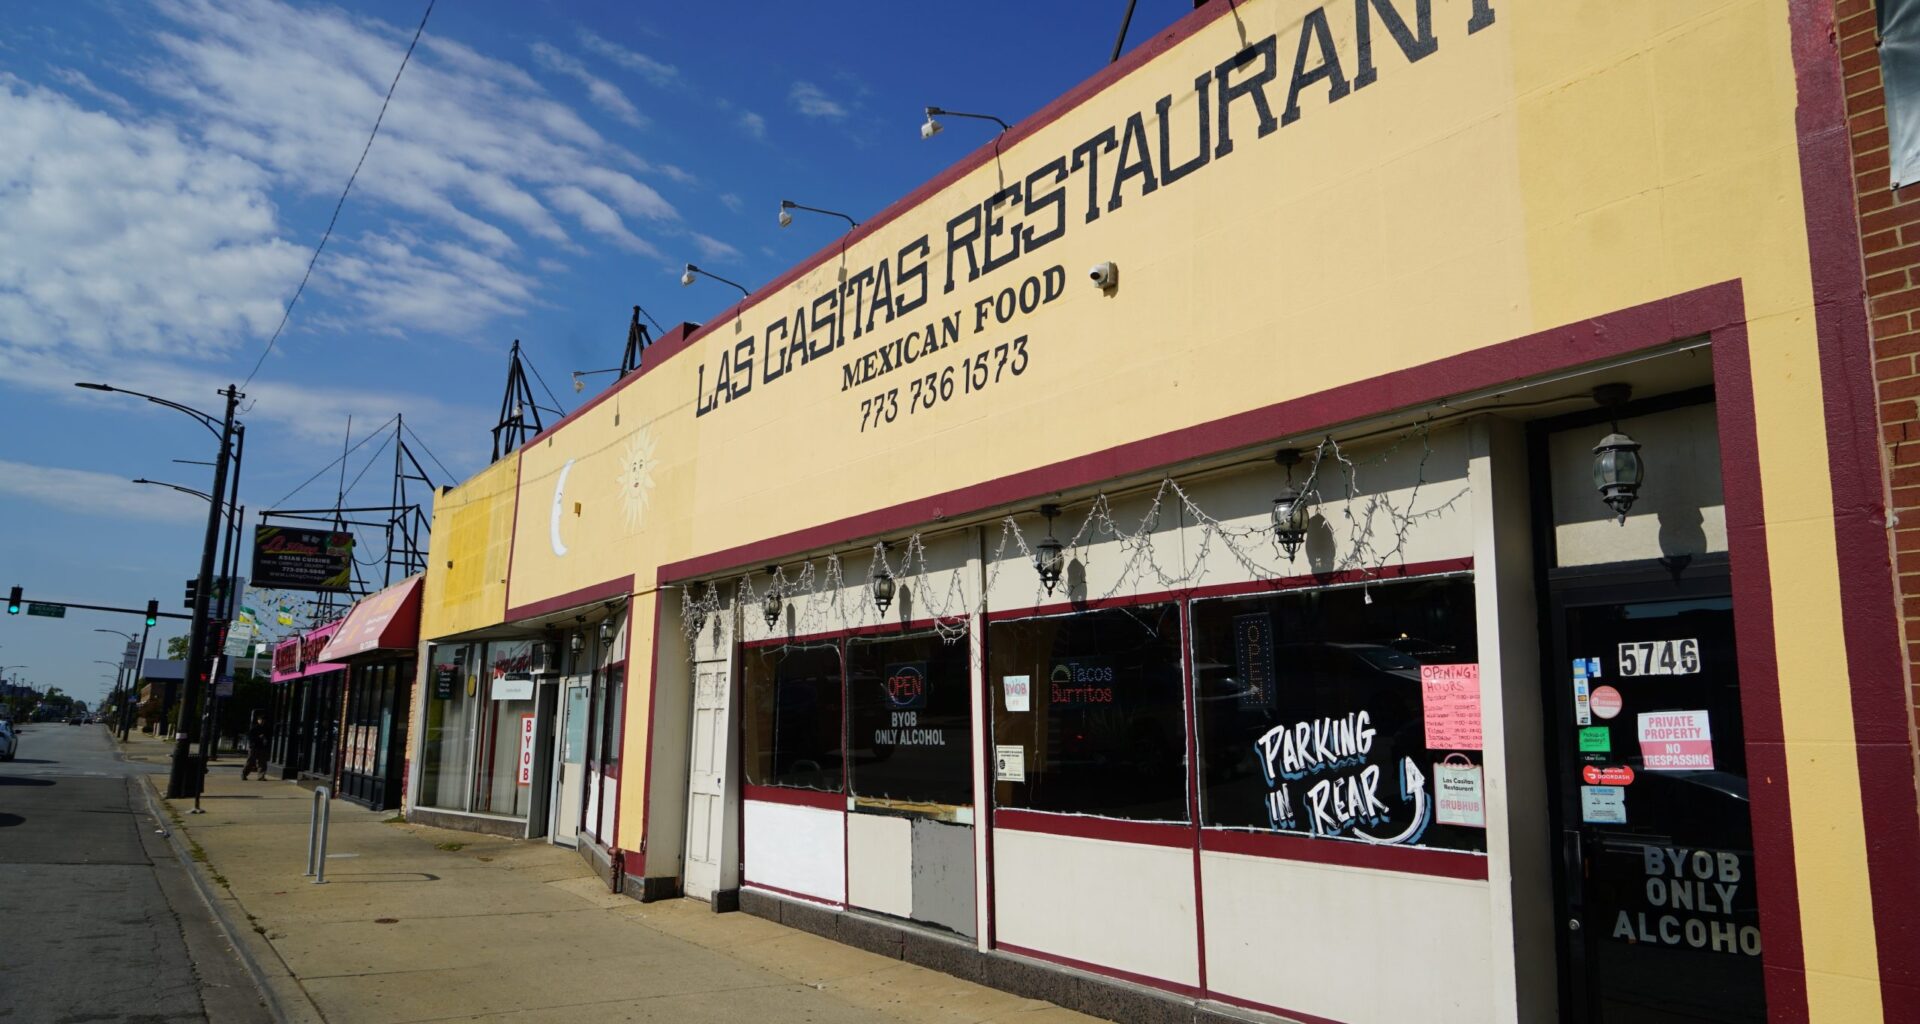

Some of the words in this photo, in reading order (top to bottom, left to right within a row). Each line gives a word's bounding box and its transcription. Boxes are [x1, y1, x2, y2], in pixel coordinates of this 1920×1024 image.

[696, 335, 755, 418] LAS
[763, 234, 930, 385] CASITAS
[944, 0, 1496, 294] RESTAURAN
[841, 310, 962, 392] MEXICAN
[973, 264, 1066, 334] FOOD
[860, 388, 899, 433] 773
[910, 365, 955, 415] 736
[962, 334, 1029, 395] 1573
[1620, 640, 1697, 676] 5746
[1069, 662, 1113, 682] Tacos
[887, 674, 922, 697] OPEN
[1051, 683, 1113, 703] Burritos
[1427, 680, 1465, 693] HOURS
[891, 711, 918, 727] BYOB
[1648, 715, 1694, 728] PRIVATE
[875, 729, 898, 745] ONLY
[899, 729, 946, 746] ALCOHOL
[1644, 727, 1701, 740] PROPERTY
[523, 719, 532, 781] BYOB
[1256, 710, 1377, 783] PARKING
[1665, 743, 1681, 754] NO
[1644, 754, 1710, 766] TRESPASSING
[1453, 777, 1474, 785] Casitas
[1267, 783, 1295, 826] IN
[1305, 764, 1389, 836] REAR
[1440, 799, 1480, 812] GRUBHUB
[1643, 846, 1741, 883] BYOB
[1645, 877, 1738, 915] ONLY
[1612, 909, 1762, 957] ALCOHO
